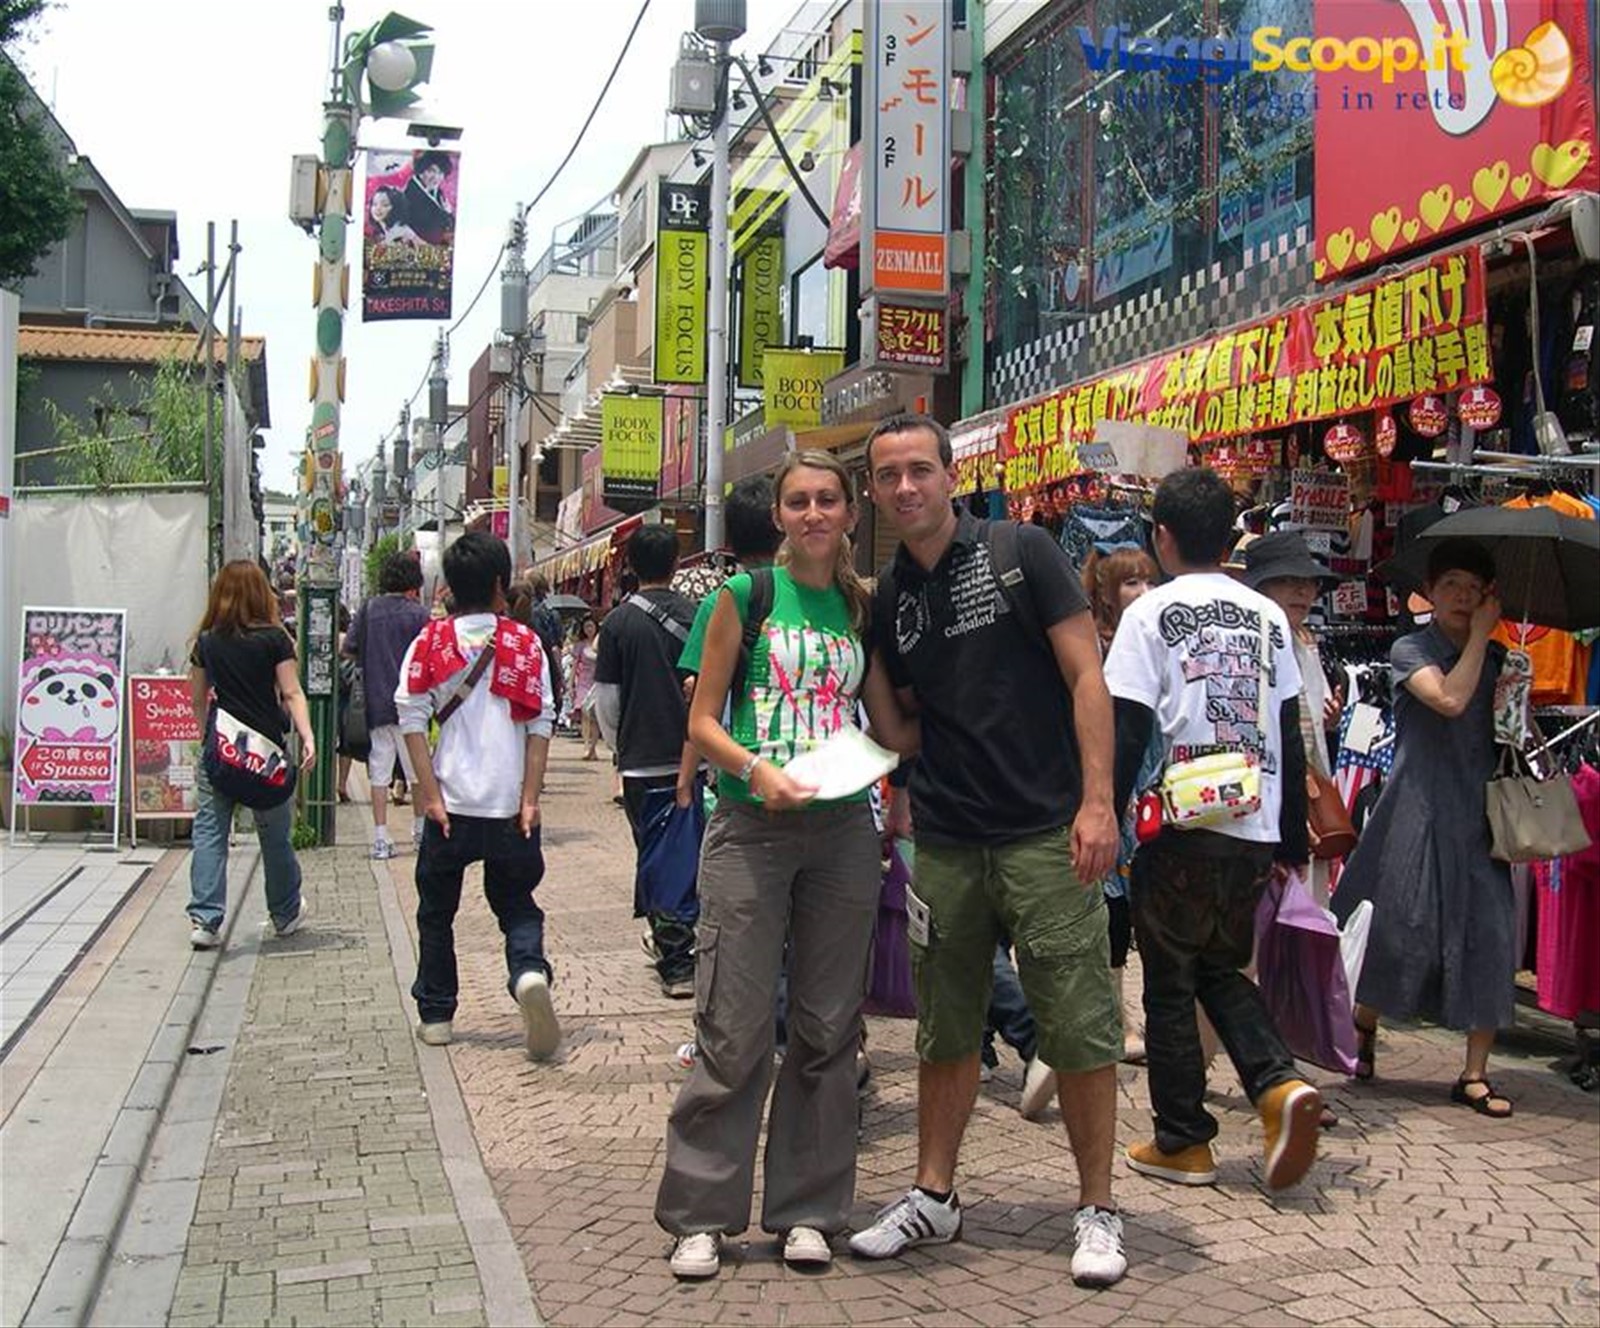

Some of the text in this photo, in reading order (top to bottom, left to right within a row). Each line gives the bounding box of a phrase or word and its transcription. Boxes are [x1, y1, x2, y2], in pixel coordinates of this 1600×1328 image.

[877, 249, 942, 275] ZENMALL
[676, 238, 696, 376] BODY FOCUS
[1314, 255, 1466, 359] 本気値下げ
[881, 308, 941, 333] ミラクル
[897, 331, 941, 353] セール
[779, 377, 824, 392] BODY
[613, 417, 652, 429] BODY
[609, 430, 655, 445] FOCUS
[42, 761, 108, 779] Spasso
